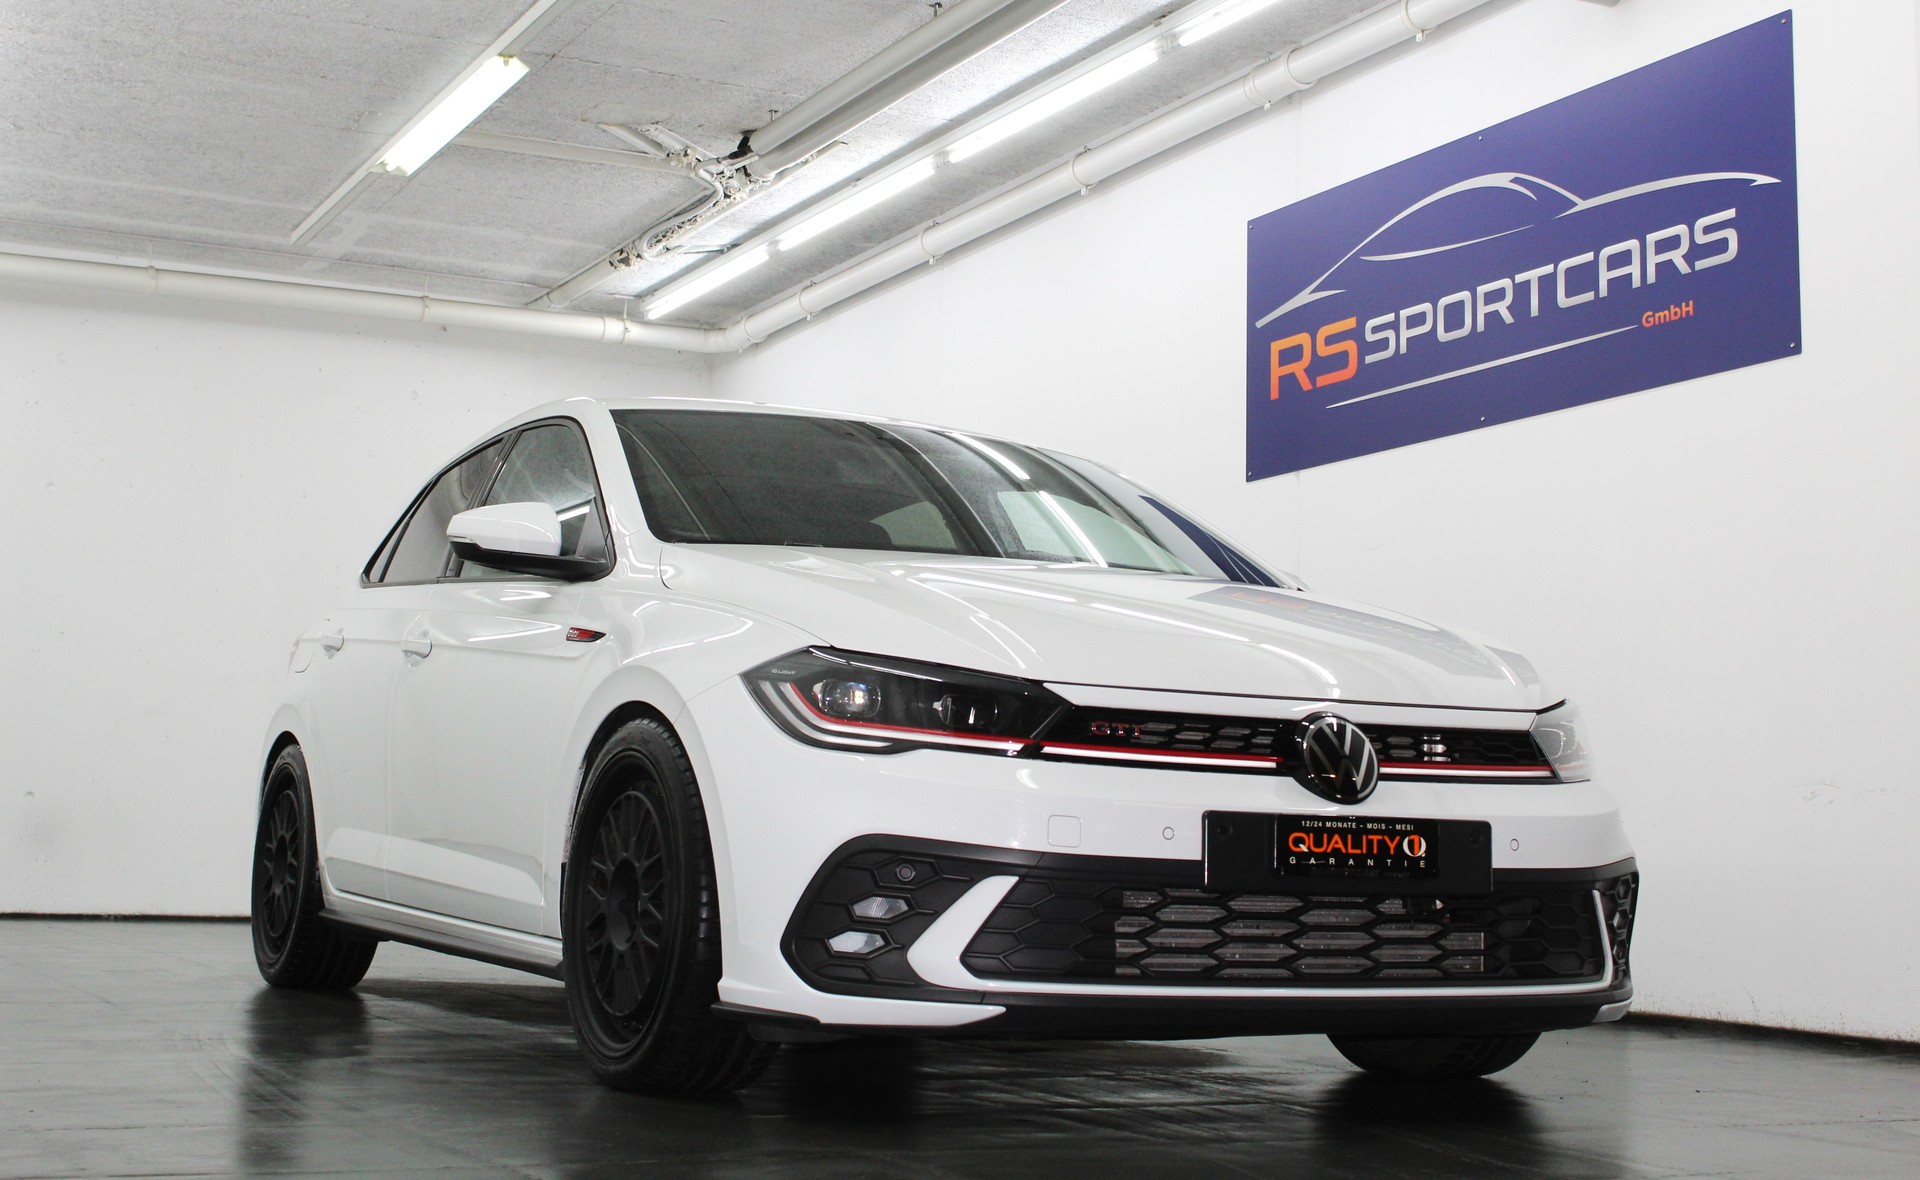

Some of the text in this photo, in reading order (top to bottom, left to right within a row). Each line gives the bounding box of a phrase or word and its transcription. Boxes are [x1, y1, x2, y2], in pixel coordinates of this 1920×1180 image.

[1269, 207, 1739, 400] RS SPORTCARS
[1641, 300, 1695, 328] GmbH
[1091, 721, 1142, 738] GTI
[1301, 820, 1323, 828] 12/24
[1325, 821, 1357, 829] MONATE
[1366, 822, 1386, 830] MOIS
[1395, 823, 1414, 831] MESI
[1288, 832, 1400, 855] QUALITY
[1289, 856, 1426, 868] GARANTIE
